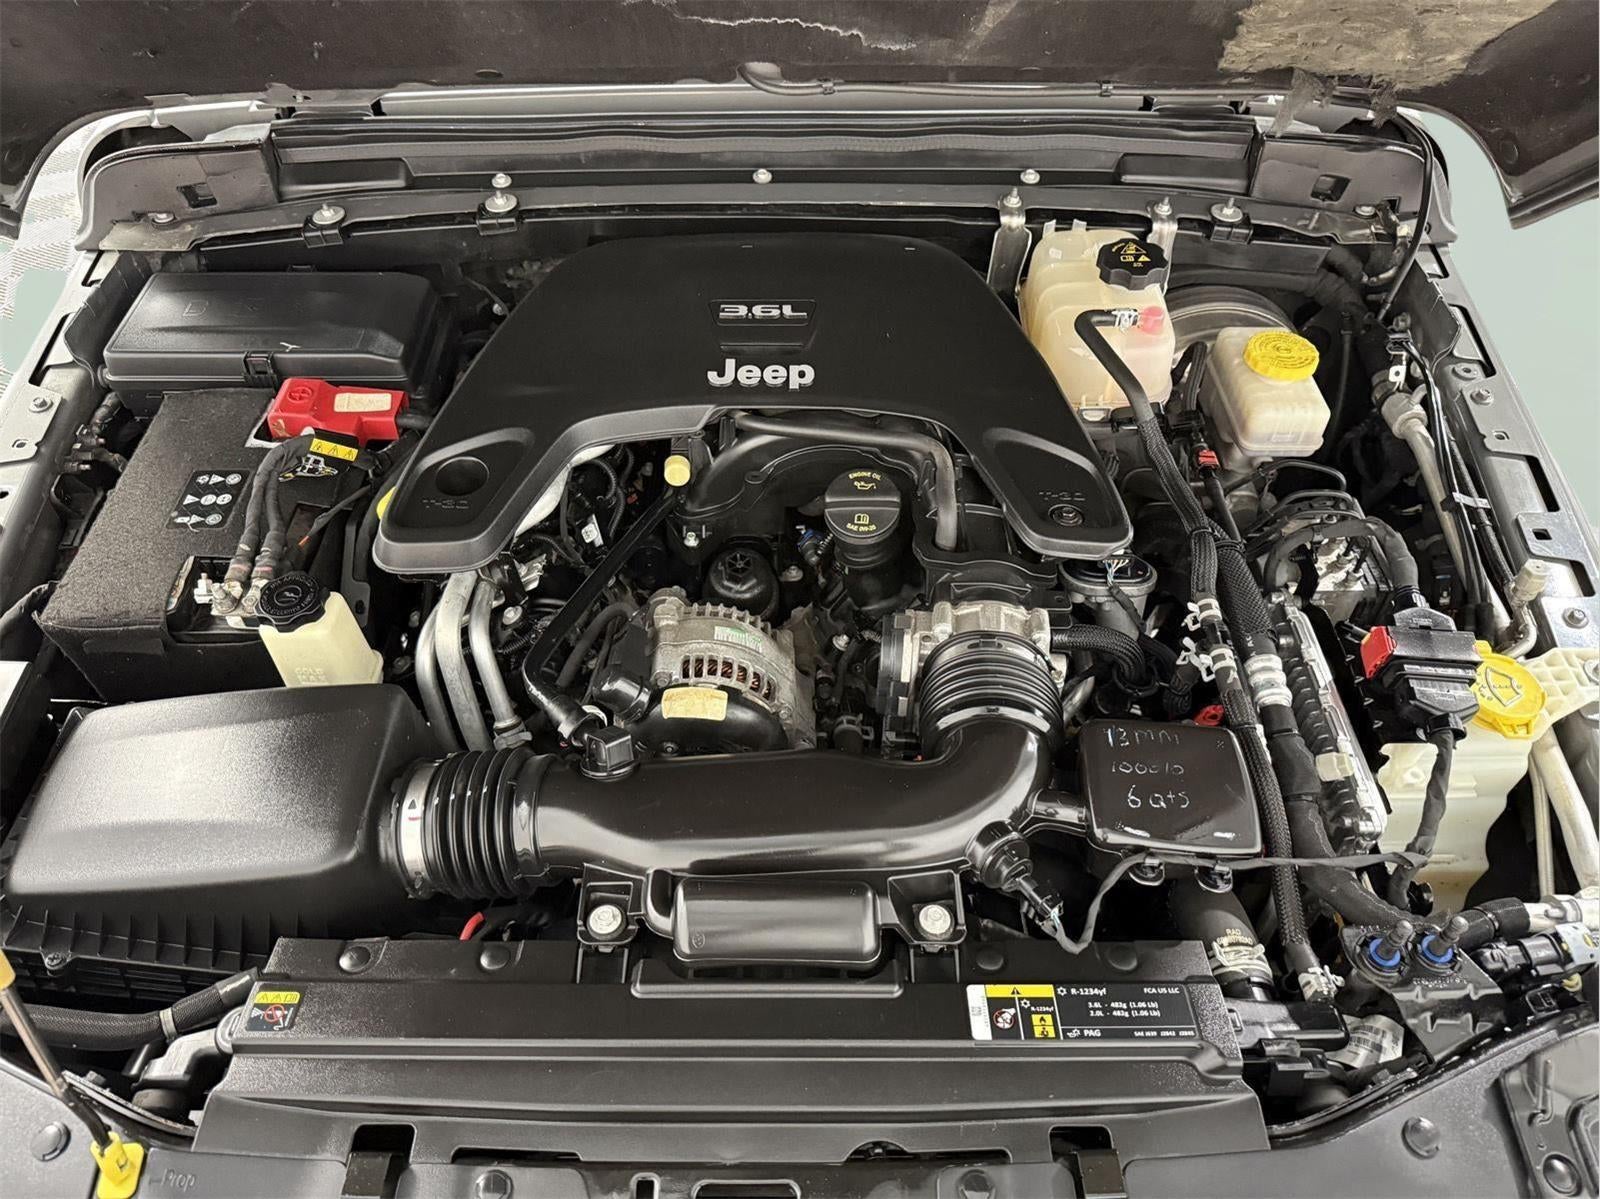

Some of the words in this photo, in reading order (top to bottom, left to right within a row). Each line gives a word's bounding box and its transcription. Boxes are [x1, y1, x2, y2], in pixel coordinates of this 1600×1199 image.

[719, 304, 808, 319] 3.6L
[707, 358, 815, 390] Jeep
[848, 471, 871, 479] ENGINE
[872, 472, 882, 481] OIL
[1127, 784, 1142, 808] 6
[1070, 987, 1106, 996] R-1234yf
[1083, 1029, 1101, 1037] PAG
